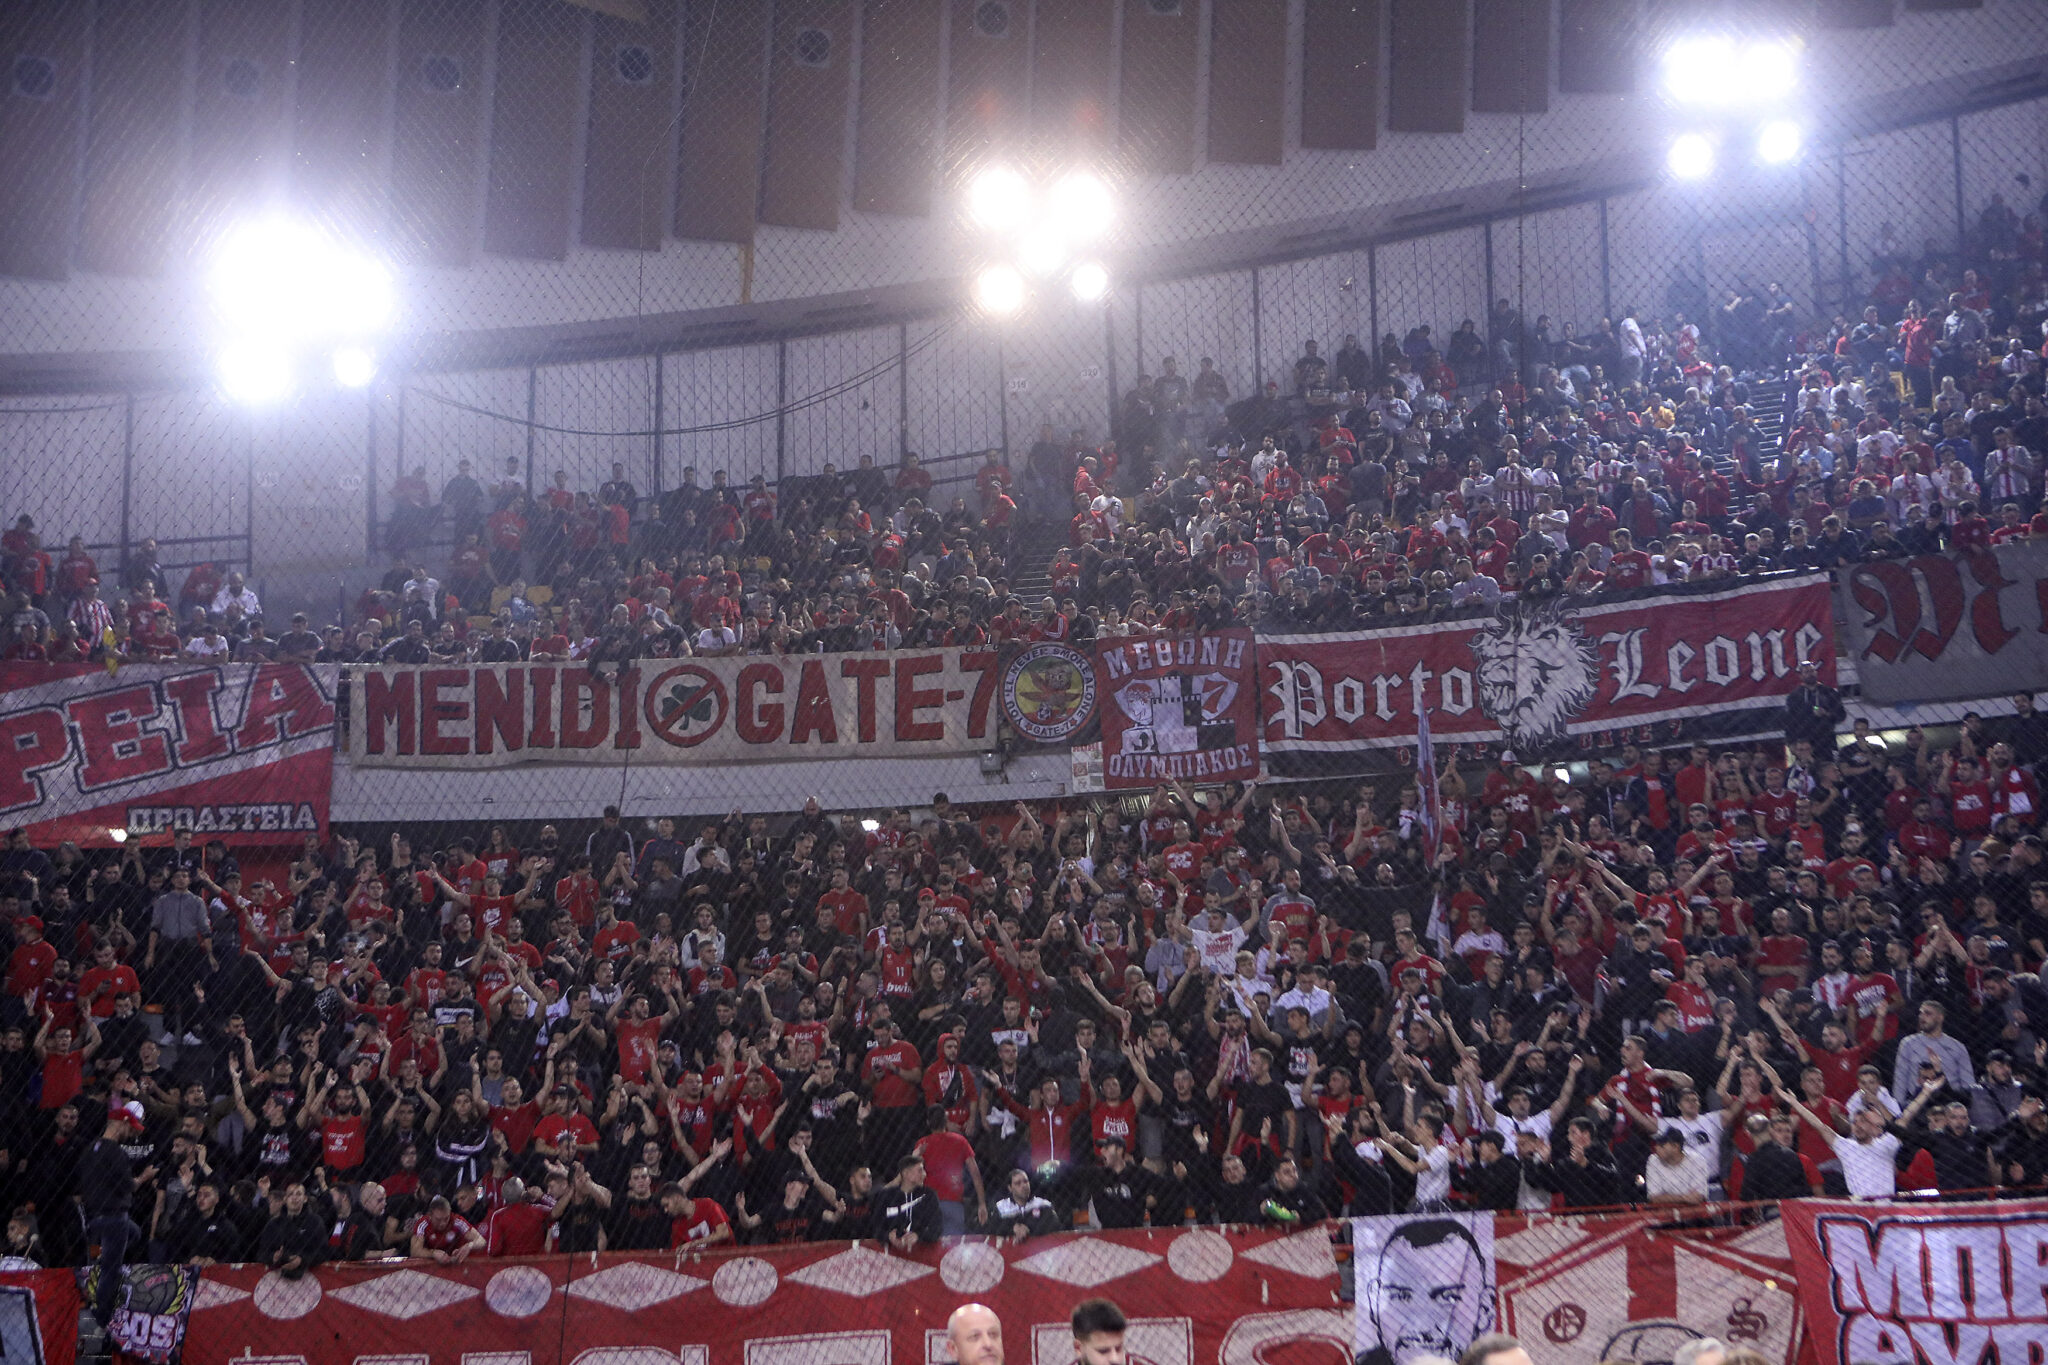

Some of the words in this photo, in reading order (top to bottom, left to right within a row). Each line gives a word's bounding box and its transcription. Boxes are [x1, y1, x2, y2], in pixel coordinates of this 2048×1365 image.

[1102, 636, 1246, 680] ΜΕΘΩΝΗ
[1267, 659, 1474, 740] Porto
[1602, 620, 1825, 703] Leone
[363, 666, 642, 758] MENIDI
[734, 650, 998, 746] GATE-7
[1053, 647, 1089, 675] SMOKE
[1077, 677, 1094, 720] ALONE
[1033, 720, 1070, 737] GATE-7
[1108, 743, 1253, 779] ΟΛΥΜΠΙΑΚΟΣ
[128, 802, 318, 834] ΠΡΟΑΣΤΕΙΑ
